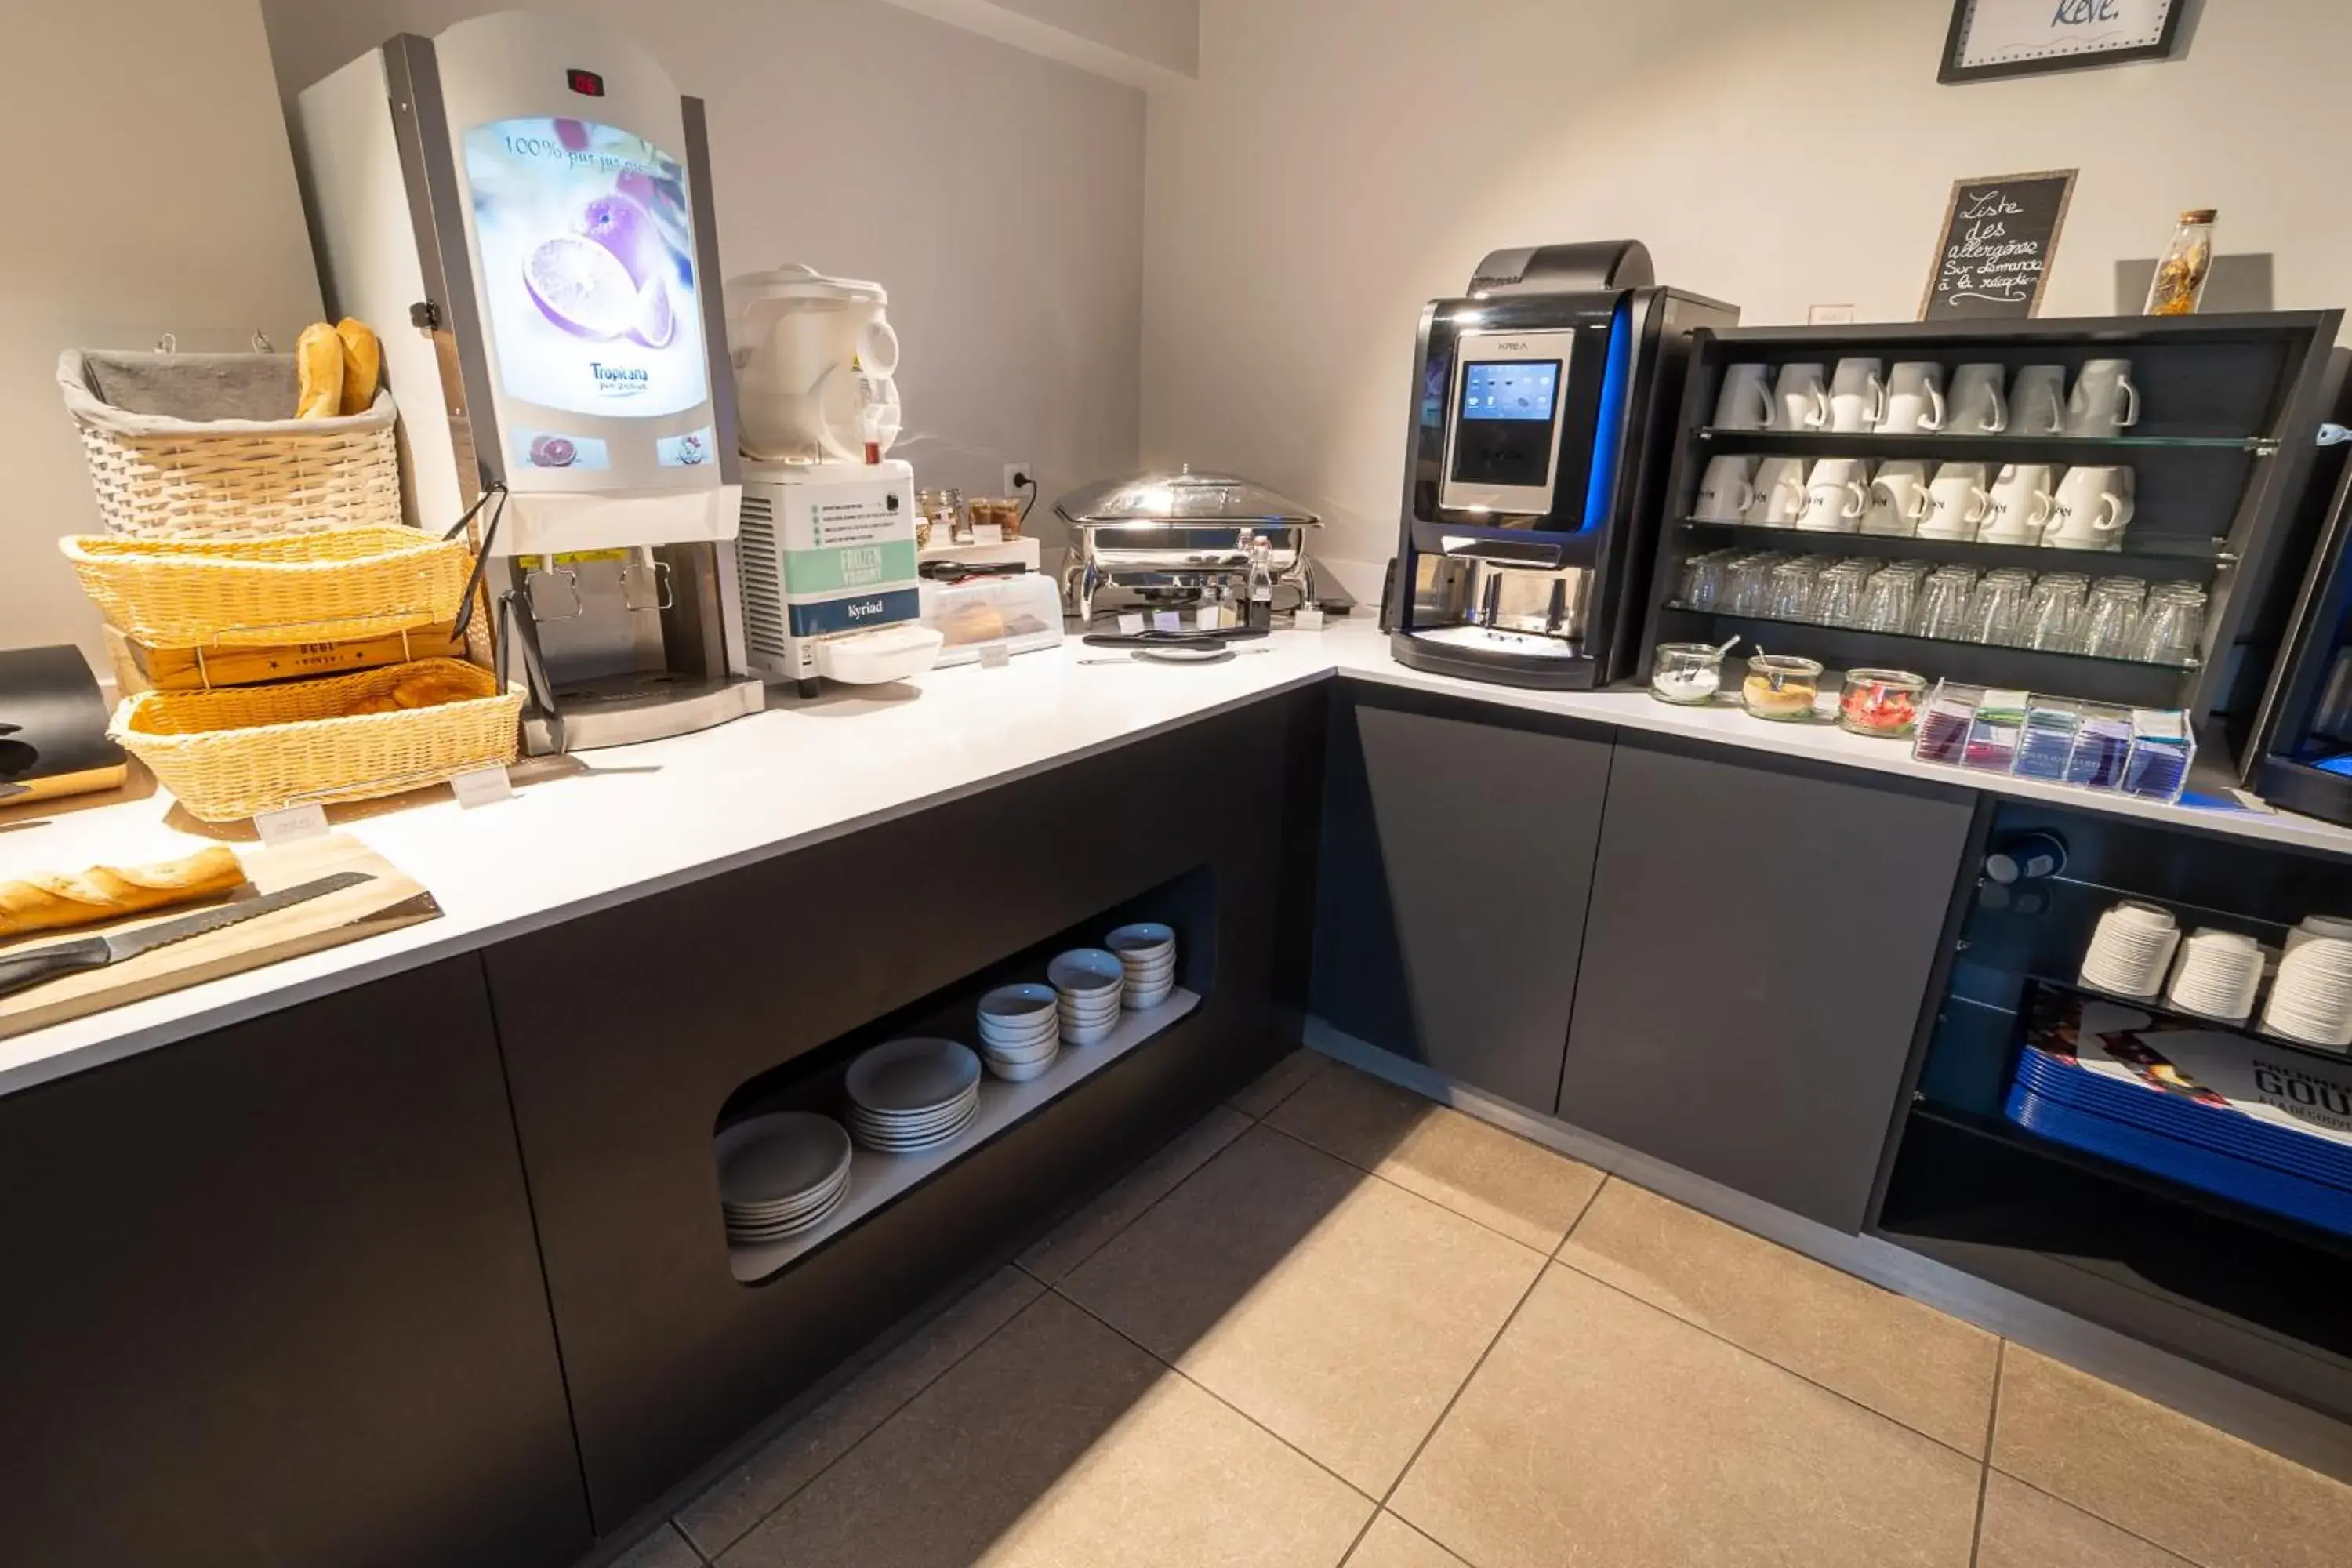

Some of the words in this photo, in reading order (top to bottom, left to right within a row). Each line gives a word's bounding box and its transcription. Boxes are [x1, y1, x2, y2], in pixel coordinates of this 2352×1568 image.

[505, 136, 562, 158] 100%
[1959, 190, 2024, 219] Liste
[1965, 219, 2007, 241] des
[1944, 260, 1973, 275] Sur
[1957, 274, 1974, 289] la
[589, 362, 648, 382] Tropicana
[848, 600, 884, 620] Kyriad
[2255, 1068, 2352, 1116] GOU
